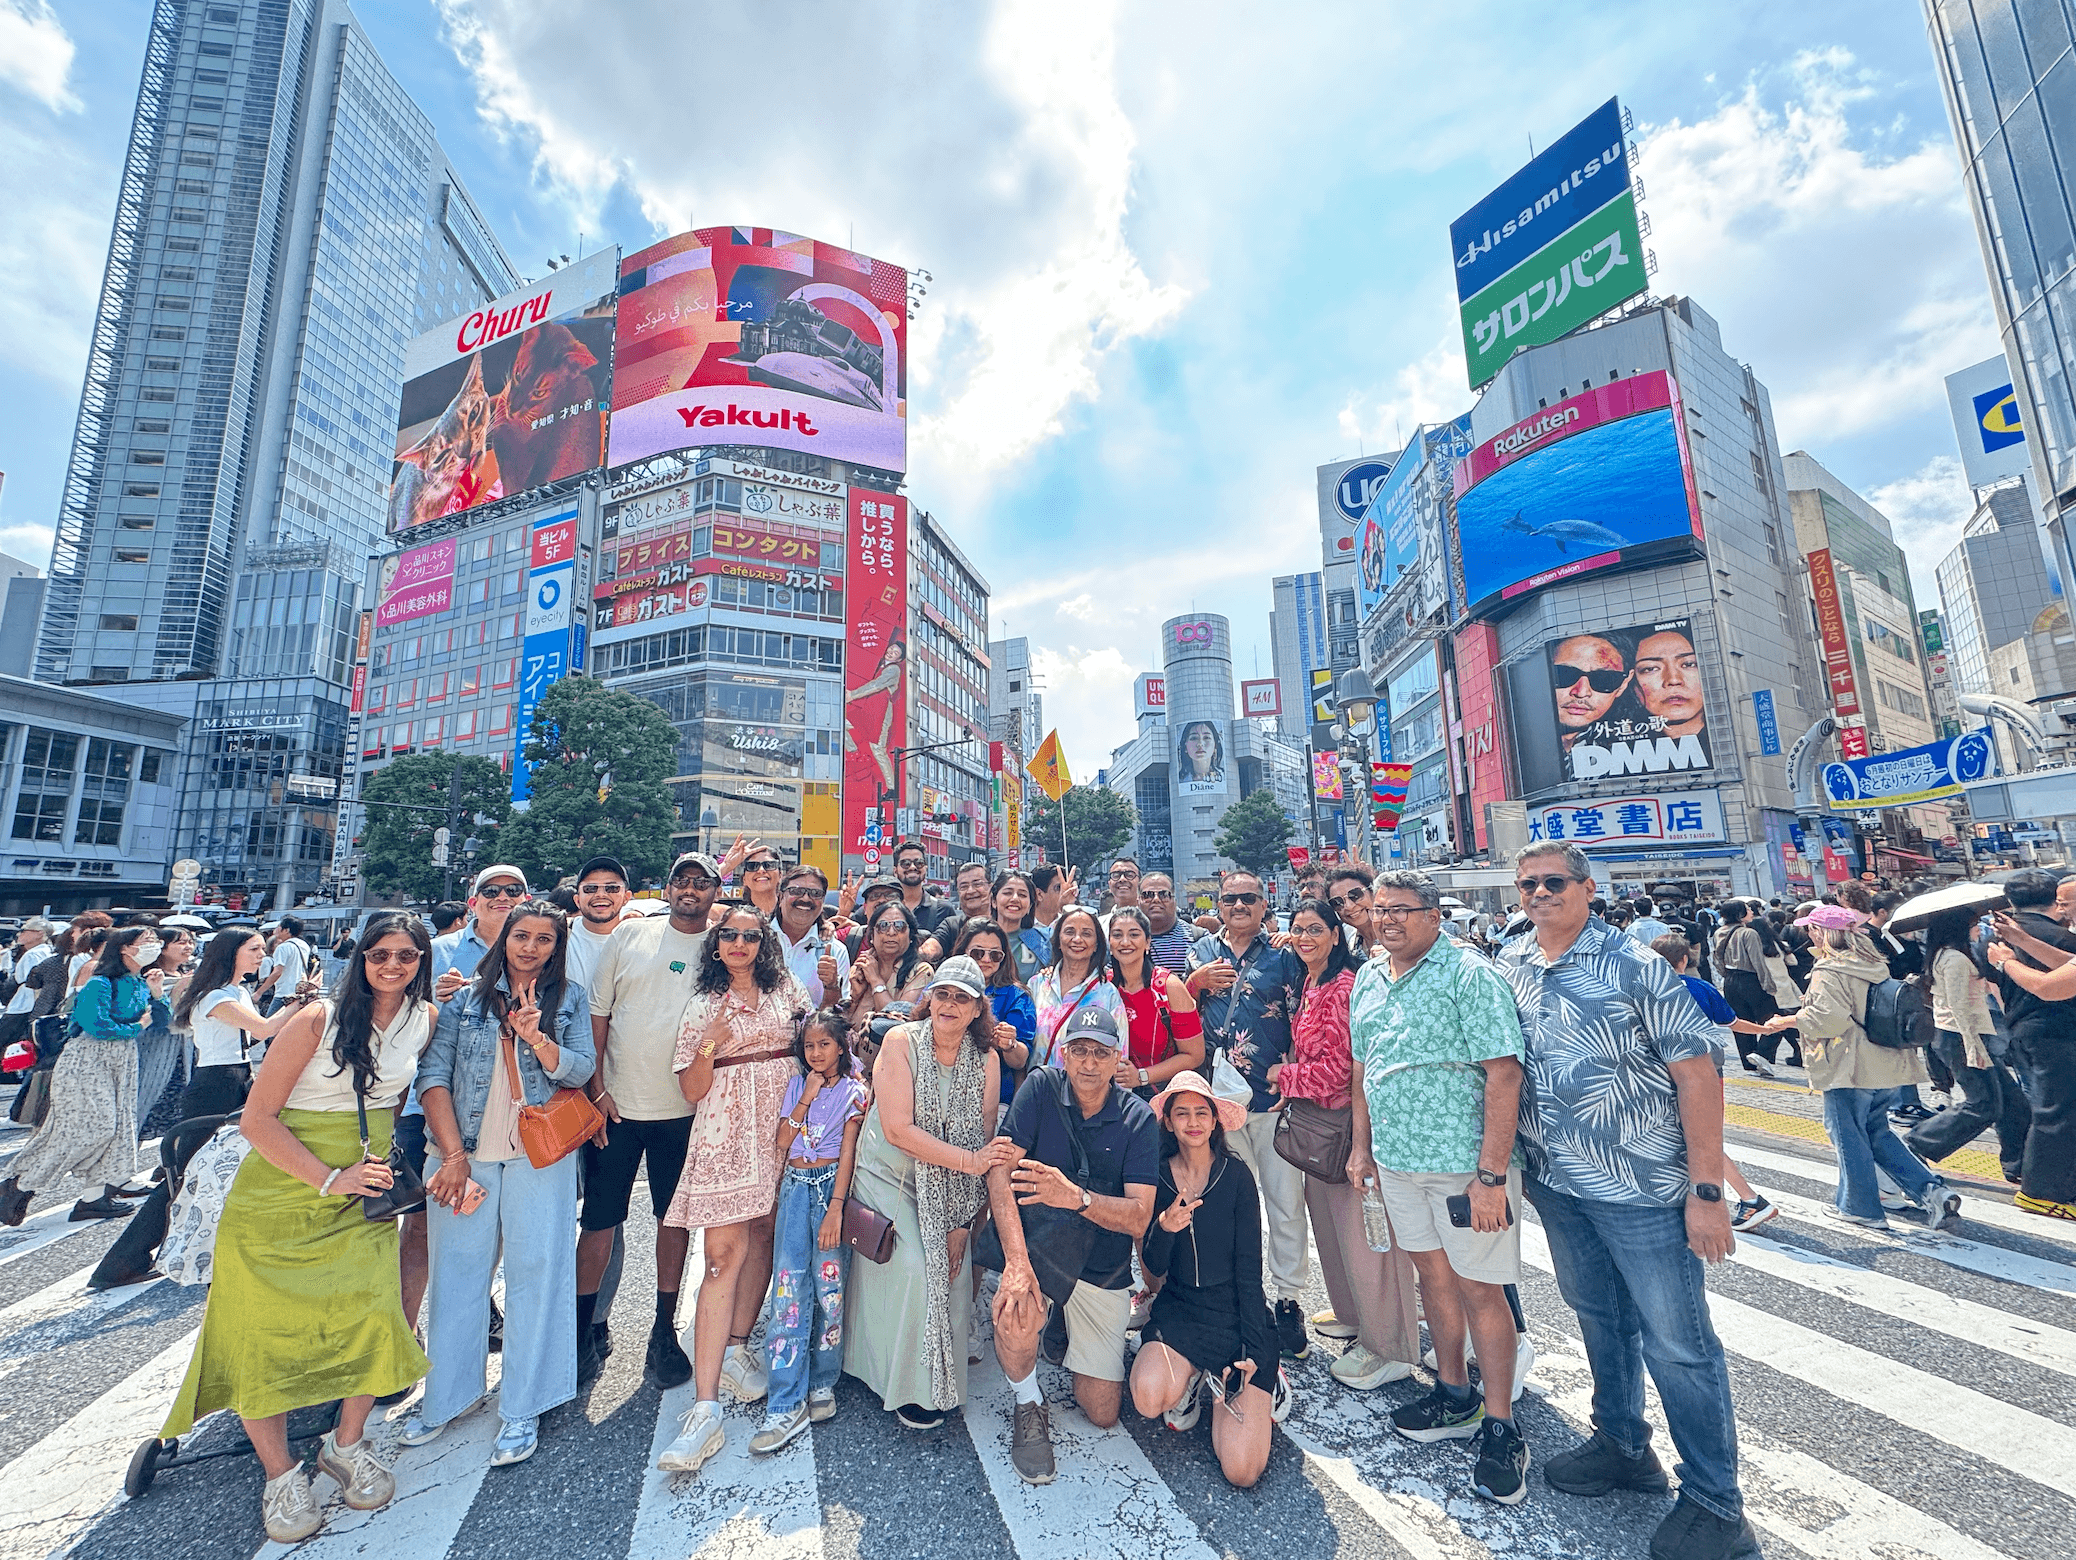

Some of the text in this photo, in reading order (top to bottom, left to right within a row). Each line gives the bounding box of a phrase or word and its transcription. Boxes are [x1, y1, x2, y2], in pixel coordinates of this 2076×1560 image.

[1456, 141, 1621, 269] Hisamitsu
[1472, 230, 1629, 355] サロンパス
[457, 290, 553, 353] Churu
[677, 404, 819, 436] Yakult
[1493, 406, 1579, 457] Rakuten
[610, 468, 689, 500] しゃぶしゃぶバイキング
[732, 463, 840, 493] しゃぶしゃぶバイキング
[645, 491, 691, 518] しゃぶ葉
[779, 493, 842, 521] しゃぶ葉
[605, 515, 618, 528] 9F
[539, 527, 569, 547] 当ビル
[619, 533, 690, 568] プライス
[714, 528, 817, 560] コンタクト
[860, 500, 877, 574] 推しから。
[879, 503, 895, 577] 買うなら、
[413, 546, 452, 568] 品川スキン
[545, 545, 560, 560] 5F
[412, 561, 447, 580] クリニック
[658, 564, 694, 586] ガスト
[785, 570, 833, 592] ガスト
[1529, 564, 1580, 587] Rakuten Vision
[386, 589, 448, 619] 品川美容外科
[638, 593, 683, 621] ガスト
[1812, 553, 1840, 644] クスリのことなら
[530, 609, 565, 626] eyecity
[598, 608, 613, 624] 7F
[1655, 620, 1687, 631] DMM TV
[1173, 621, 1213, 648] 109
[1149, 681, 1164, 692] UN
[1828, 649, 1857, 709] 三千里
[1252, 690, 1271, 704] H&M
[203, 716, 304, 729] MARK CITY
[229, 708, 277, 716] SHIBUYA
[1594, 714, 1671, 740] 外道の歌
[731, 734, 780, 750] Ushi8
[1571, 734, 1709, 778] DMM
[1865, 754, 1932, 776] 6月最初の日曜日は
[1860, 766, 1949, 792] おとなりサンデー
[1529, 801, 1703, 843] 大盛堂書店
